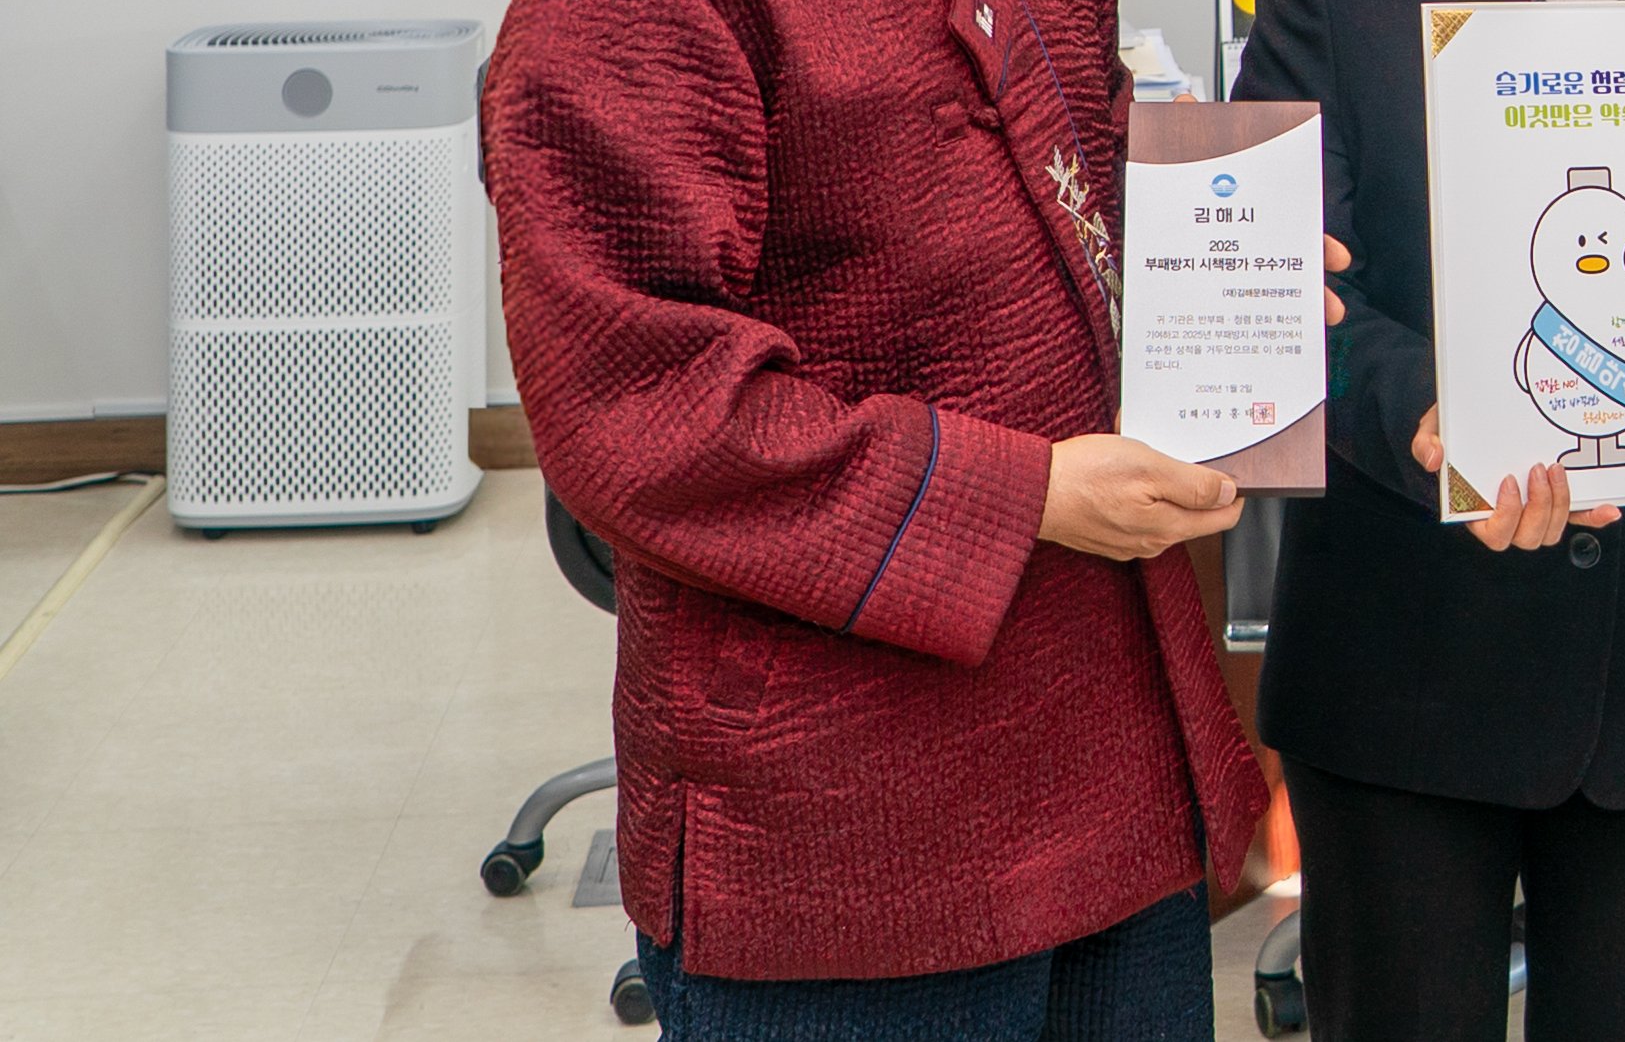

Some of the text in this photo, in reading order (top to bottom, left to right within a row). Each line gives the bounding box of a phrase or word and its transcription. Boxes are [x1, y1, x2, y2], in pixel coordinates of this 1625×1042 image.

[1496, 71, 1584, 96] 슬기로운
[1504, 104, 1593, 129] 이것만은
[1209, 240, 1240, 252] 2025
[1144, 257, 1303, 271] 부패방지 시책평가 우수기관
